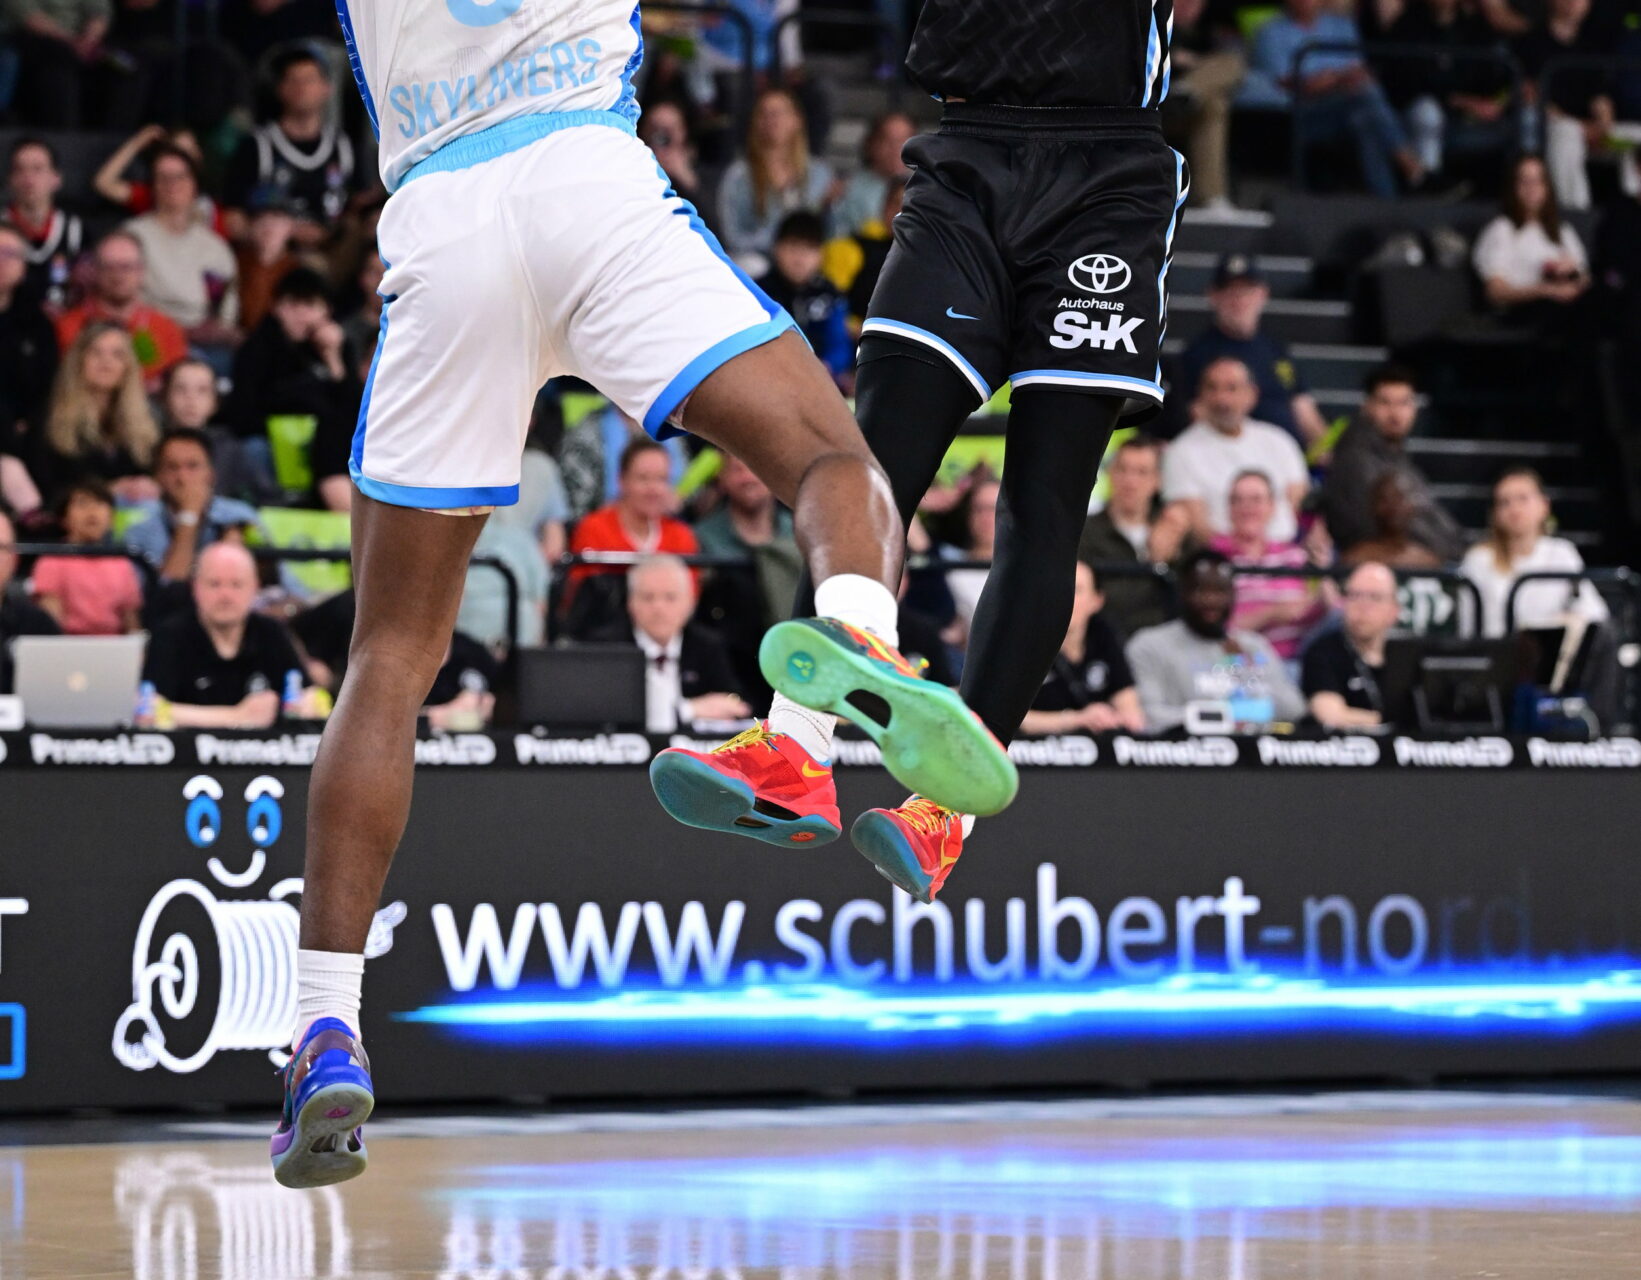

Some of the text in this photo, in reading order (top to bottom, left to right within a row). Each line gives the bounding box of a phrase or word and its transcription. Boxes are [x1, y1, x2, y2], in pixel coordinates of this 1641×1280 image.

[389, 38, 602, 139] SKYLINERS
[1058, 298, 1125, 311] Autohaus
[1049, 311, 1146, 354] S+K
